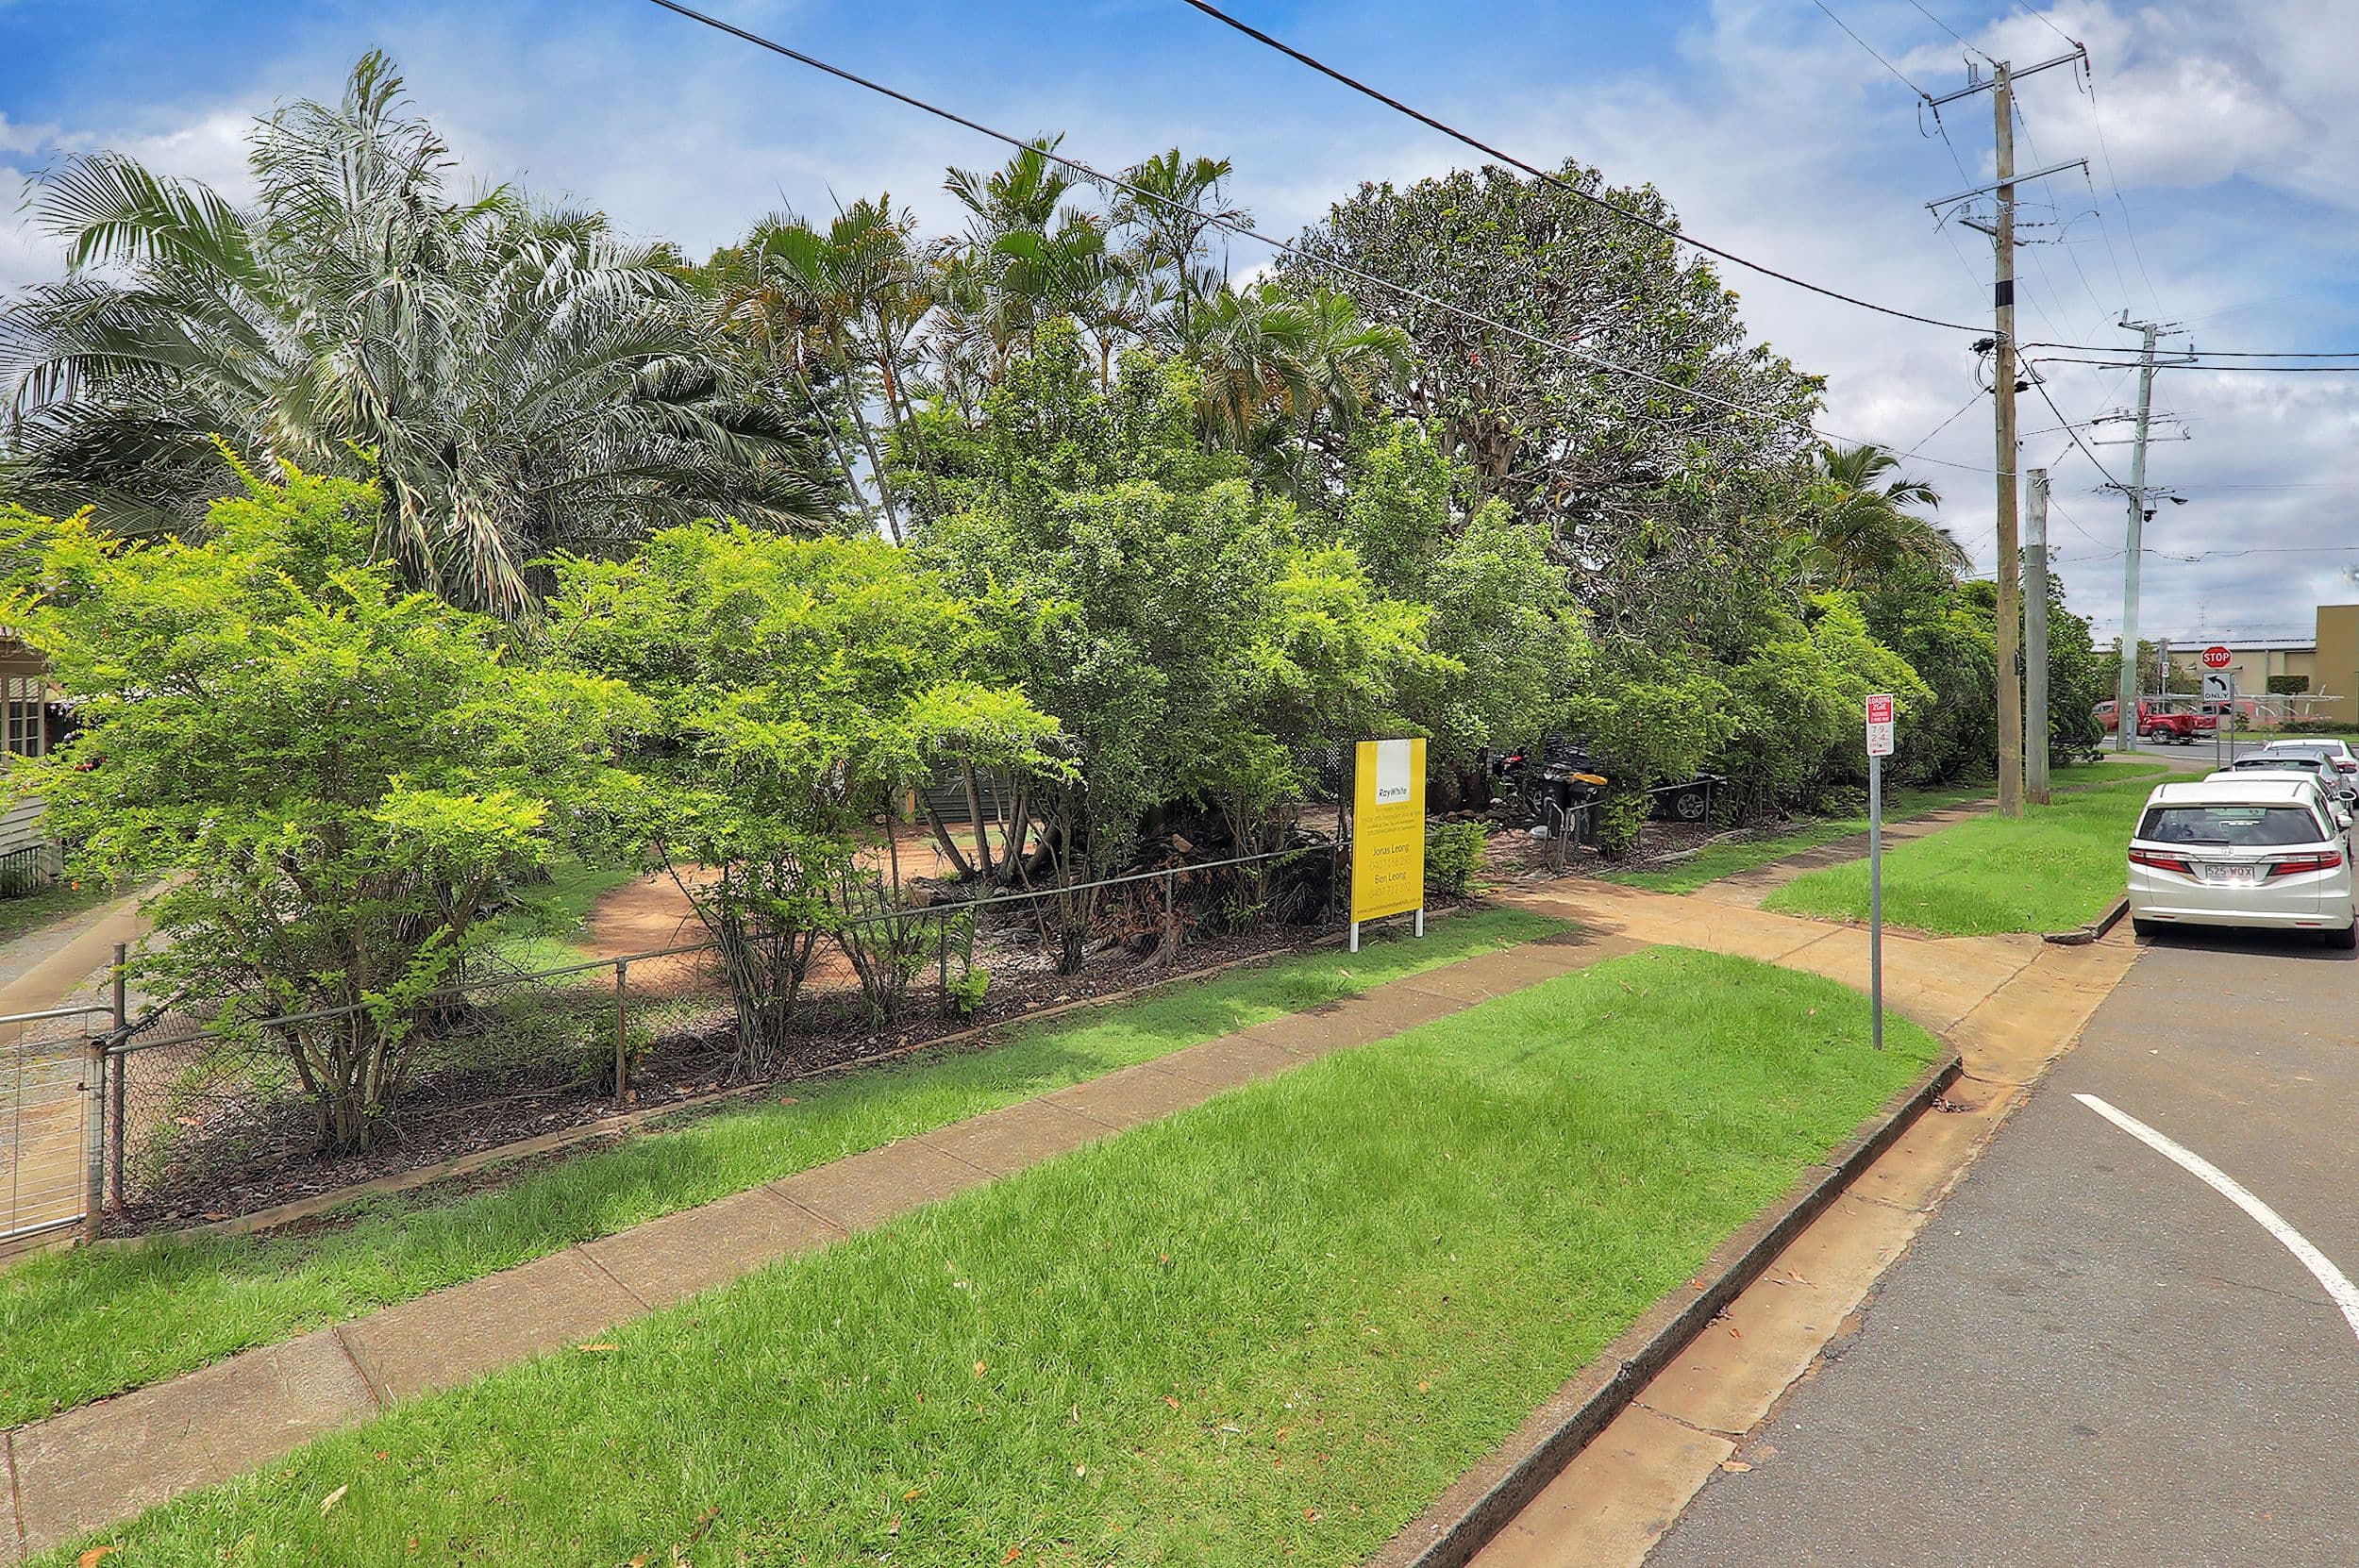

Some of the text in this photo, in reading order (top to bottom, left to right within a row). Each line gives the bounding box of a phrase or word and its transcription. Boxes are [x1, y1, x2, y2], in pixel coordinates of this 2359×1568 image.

[2203, 653, 2230, 662] STOP
[1372, 843, 1410, 857] Jonas Leong
[1374, 871, 1407, 885] Ben Leong
